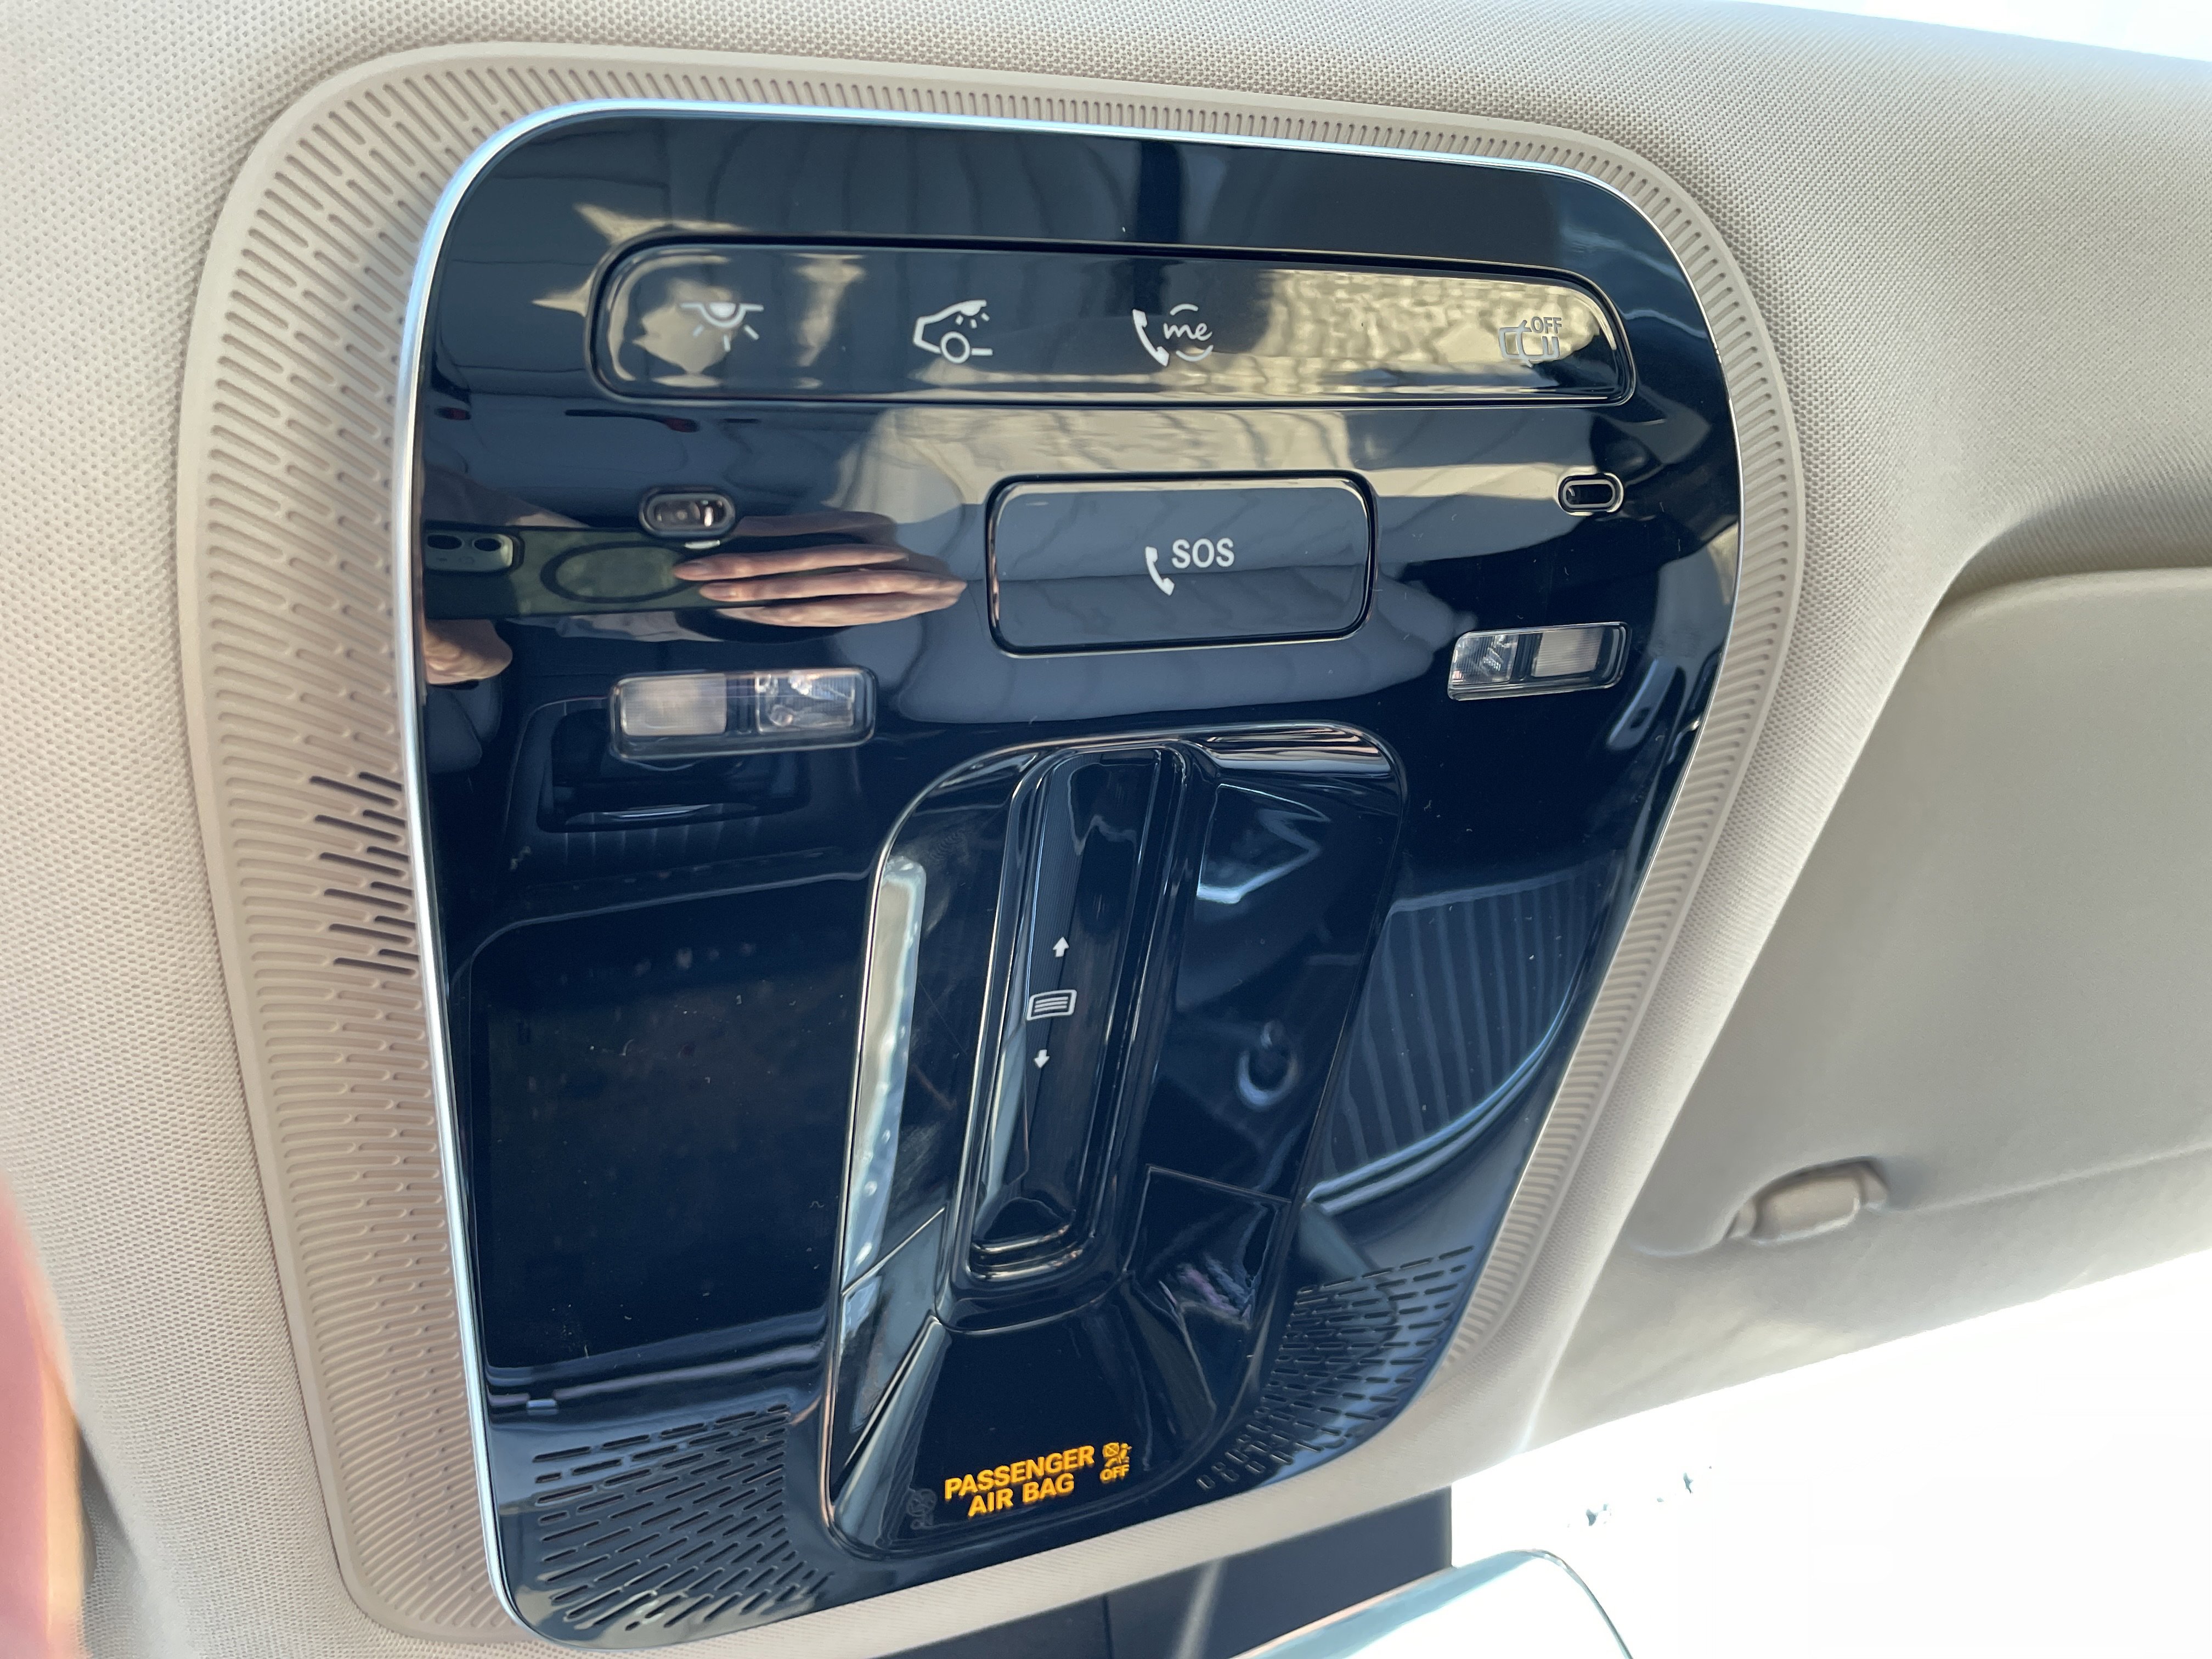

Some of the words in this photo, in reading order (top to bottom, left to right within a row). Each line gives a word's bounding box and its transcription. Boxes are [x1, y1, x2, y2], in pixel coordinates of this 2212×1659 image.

[1163, 323, 1212, 341] me
[1530, 316, 1562, 334] OFF
[1171, 537, 1235, 569] SOS
[945, 1445, 1095, 1500] PASSENGER
[1099, 1464, 1130, 1481] OFF
[968, 1488, 1014, 1518] AIR
[1022, 1472, 1075, 1503] BAG
